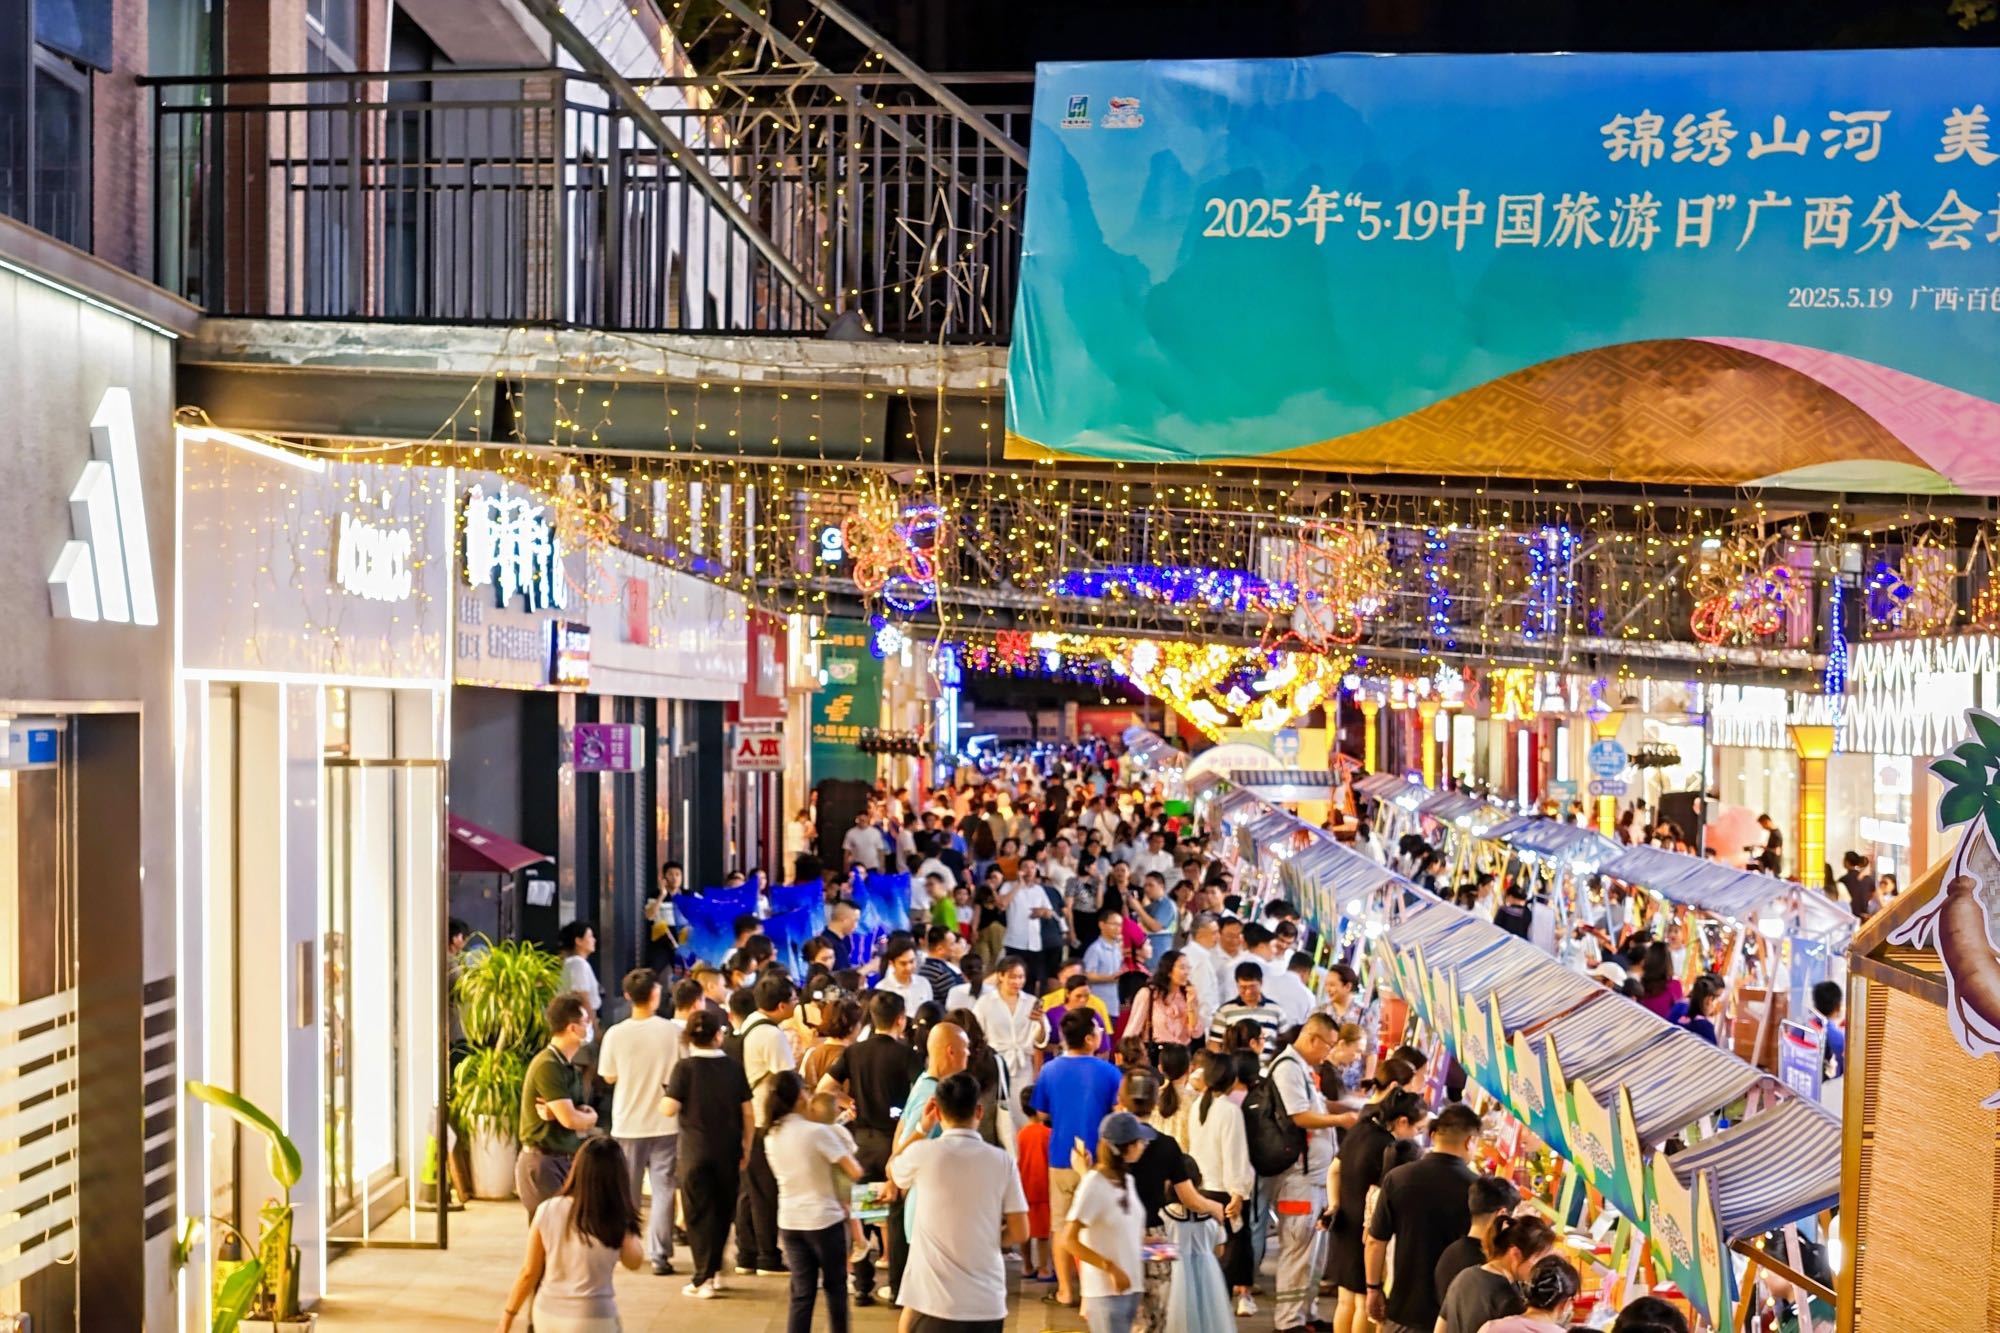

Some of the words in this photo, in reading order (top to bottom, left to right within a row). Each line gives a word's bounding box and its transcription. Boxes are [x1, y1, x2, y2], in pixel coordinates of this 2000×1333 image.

[1600, 108, 1892, 168] 锦绣山河
[1934, 104, 2000, 167] 美
[1202, 184, 2000, 254] 2025年“5·19中国旅游日”广西分会
[1787, 286, 1893, 310] 2025.5.19
[738, 737, 780, 757] 人本
